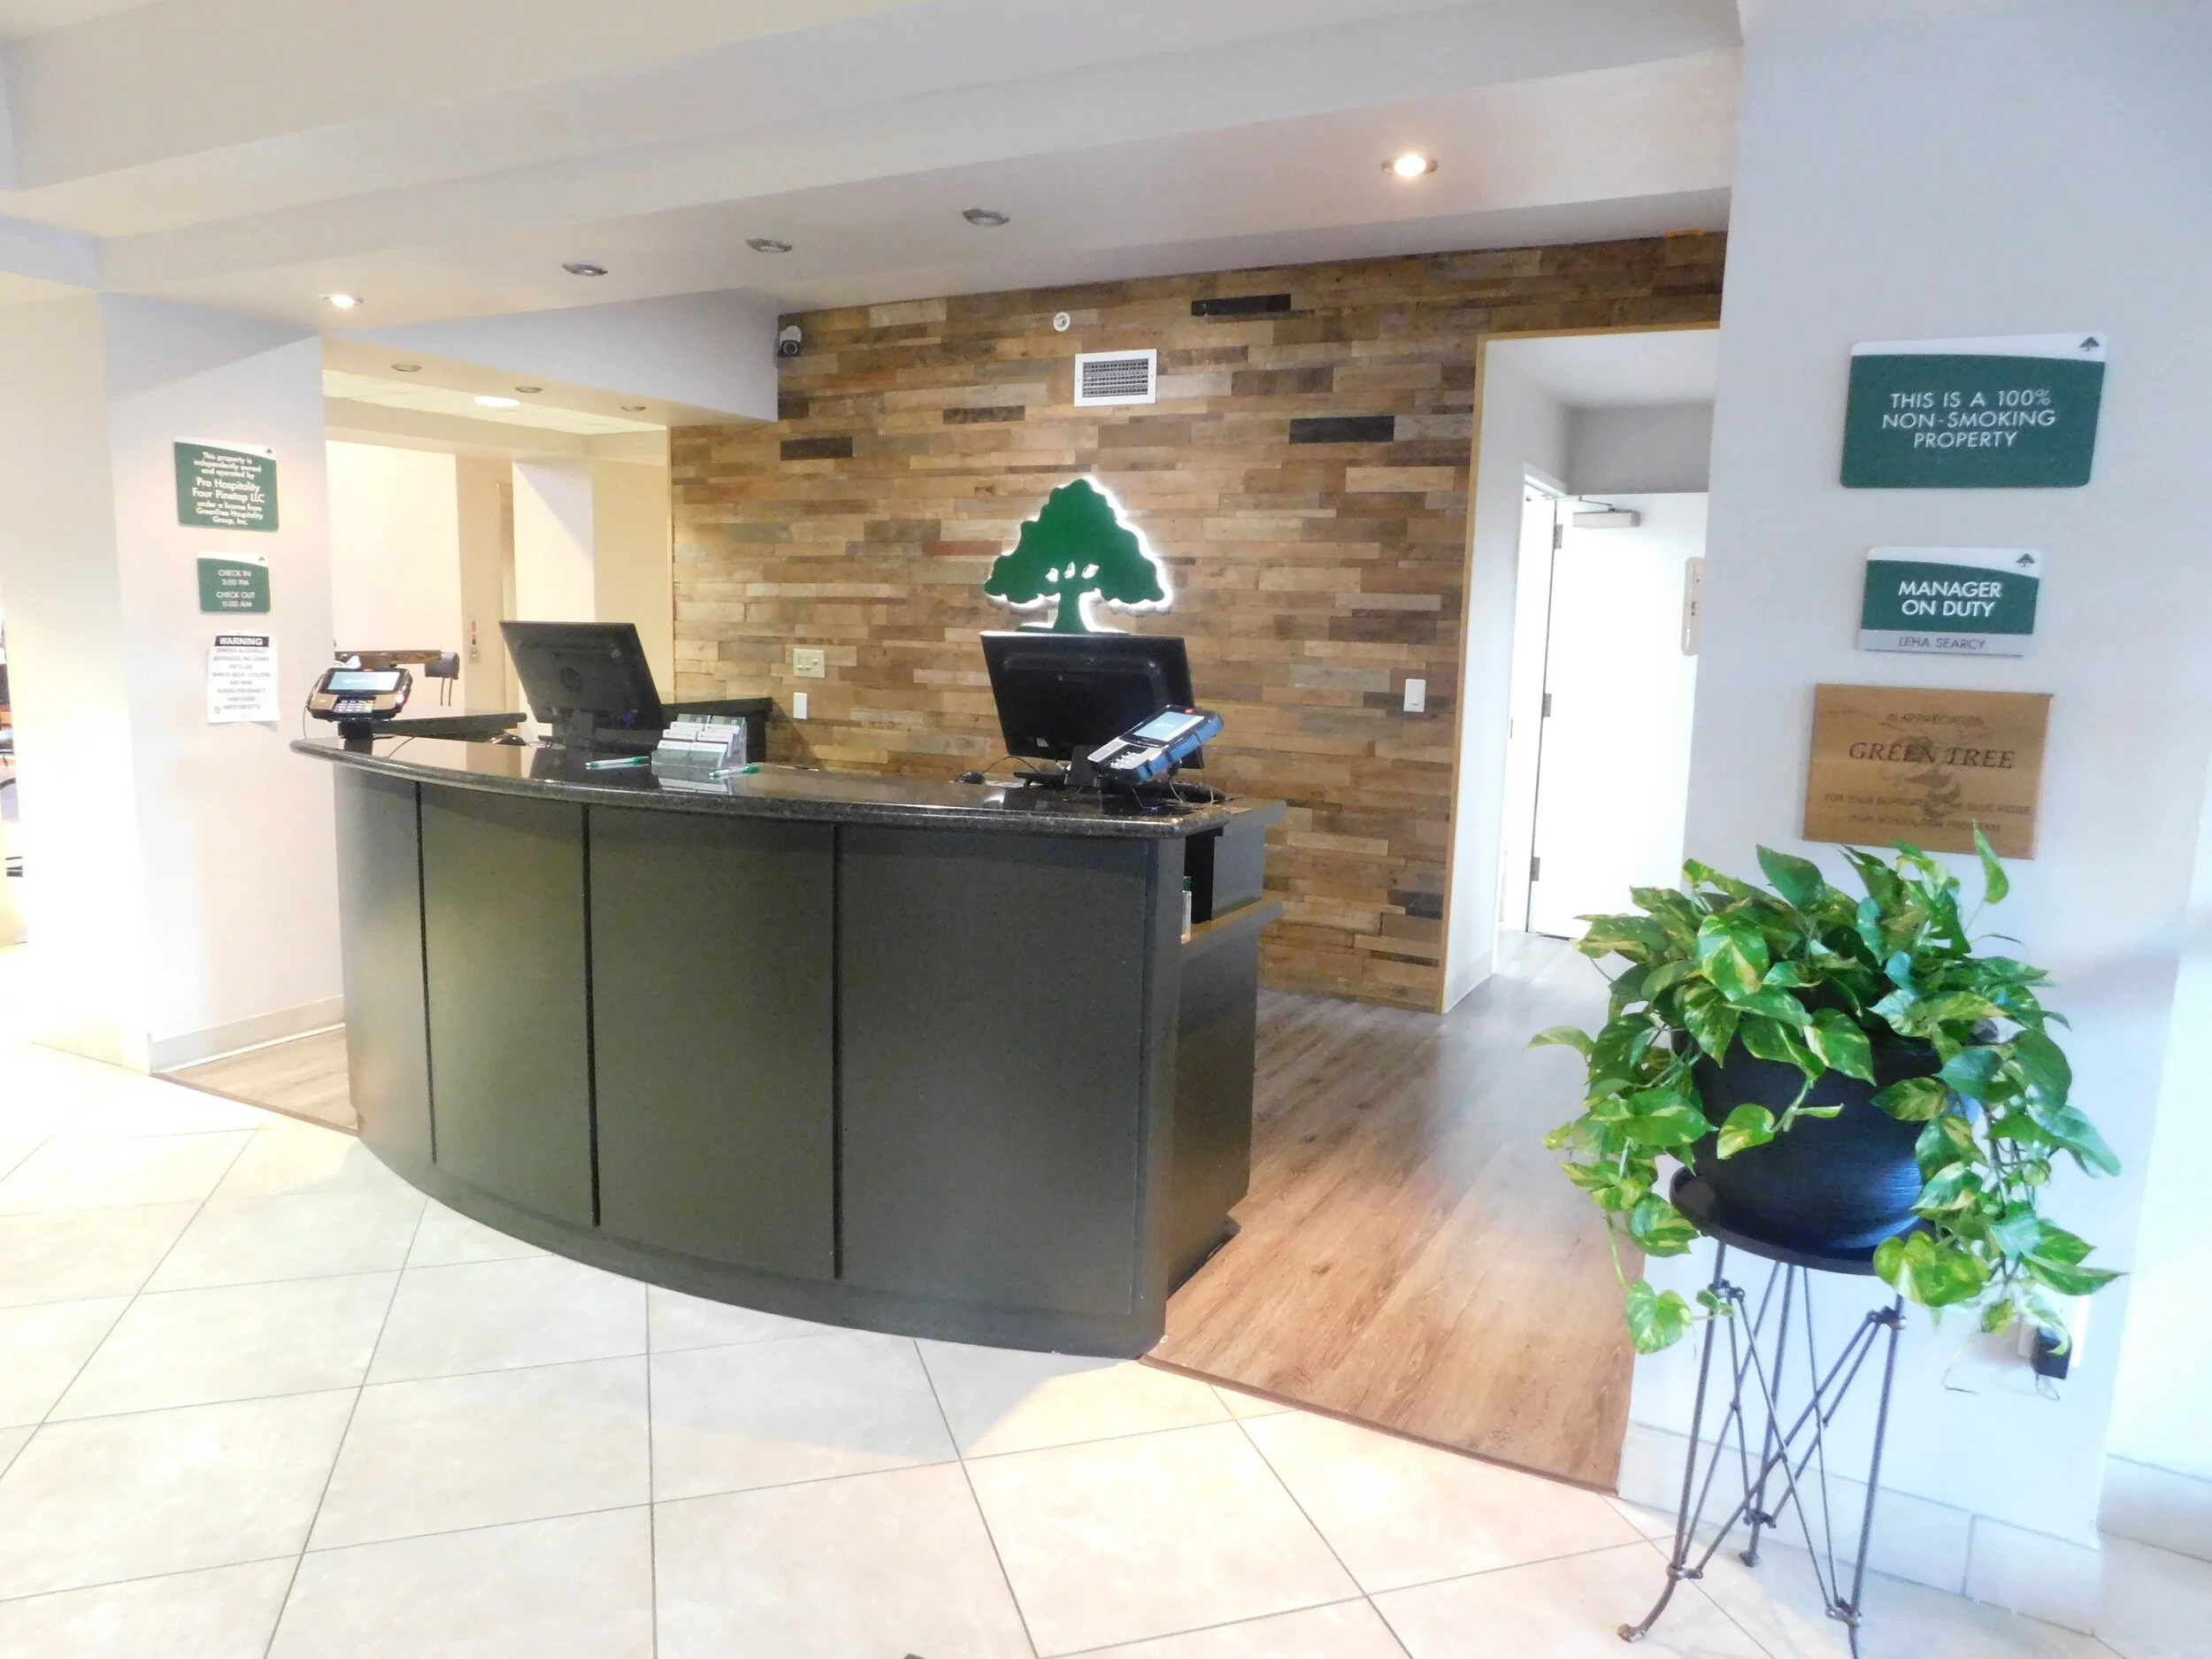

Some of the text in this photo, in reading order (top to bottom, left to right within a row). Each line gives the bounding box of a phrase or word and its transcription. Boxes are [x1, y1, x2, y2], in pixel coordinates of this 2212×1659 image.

[1890, 389, 2051, 408] THIS IS A 100%
[1882, 410, 2057, 429] NON-SMOKING
[1914, 431, 2018, 449] PROPERTY
[196, 477, 260, 493] Pro Hospitality
[192, 488, 212, 497] Four
[250, 494, 265, 503] LLC
[1898, 580, 2002, 598] MANAGER
[1901, 599, 1996, 617] ON DUTY
[1899, 635, 1986, 650] LEHA SEARCY
[1849, 741, 2016, 769] GREEN TREE
